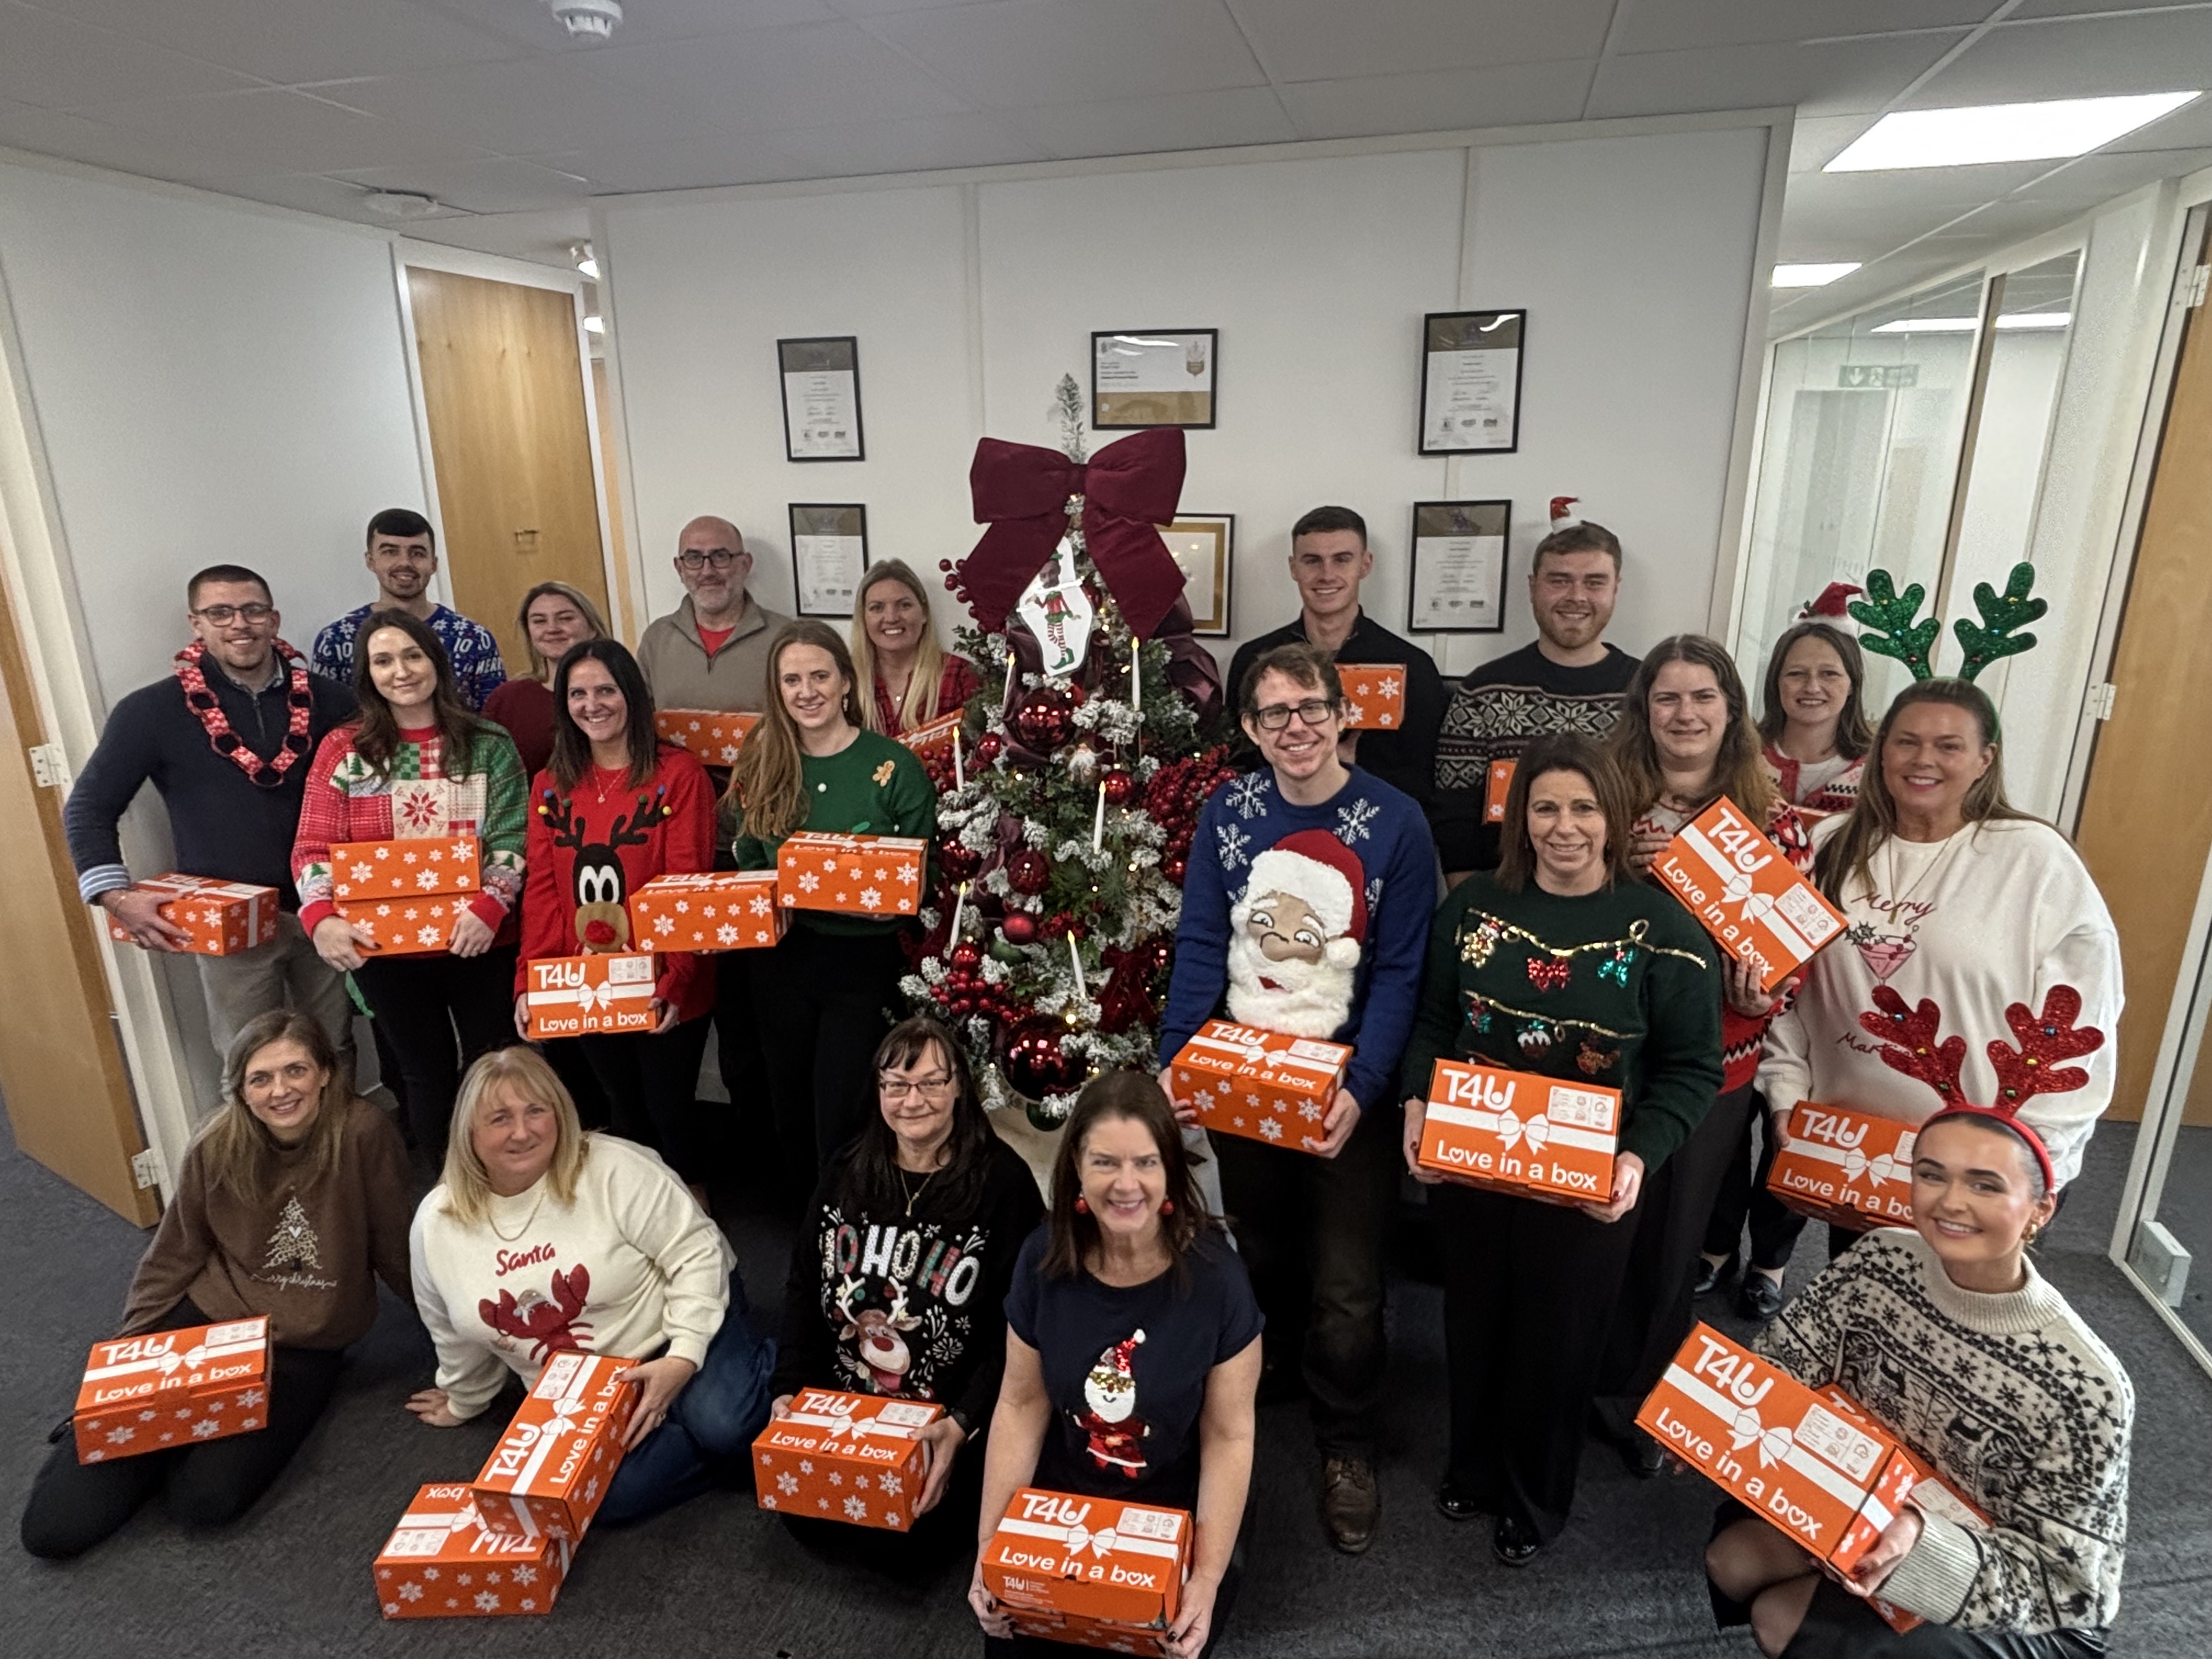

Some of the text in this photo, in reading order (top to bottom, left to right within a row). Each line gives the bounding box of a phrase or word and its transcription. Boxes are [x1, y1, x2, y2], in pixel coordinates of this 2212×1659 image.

[1708, 808, 1773, 872] T4U
[1662, 857, 1706, 905] Love
[1703, 901, 1725, 926] in
[1723, 925, 1739, 941] a
[534, 962, 586, 989] T4U
[540, 1012, 647, 1031] Love in a box
[1211, 1023, 1269, 1046] T4U
[1188, 1052, 1317, 1090] Love in a box
[1442, 1069, 1516, 1110] T4U
[1802, 1109, 1869, 1148] T4U
[1436, 1140, 1598, 1192] Love in a box
[1782, 1168, 1914, 1220] Love in a bo
[495, 1242, 556, 1277] Santa
[100, 1335, 176, 1365] T4U
[94, 1363, 252, 1403] Love in a box
[1693, 1335, 1774, 1406] T4U
[800, 1392, 861, 1416] T4U
[484, 1422, 541, 1483] T4U
[550, 1440, 588, 1483] Love
[577, 1417, 599, 1435] in
[592, 1402, 608, 1413] a
[770, 1431, 899, 1461] Love in a box
[1655, 1407, 1823, 1540] Love in a box
[1022, 1493, 1091, 1525] T4U
[1000, 1546, 1156, 1588] Love in a box
[1002, 1576, 1025, 1590] T4U
